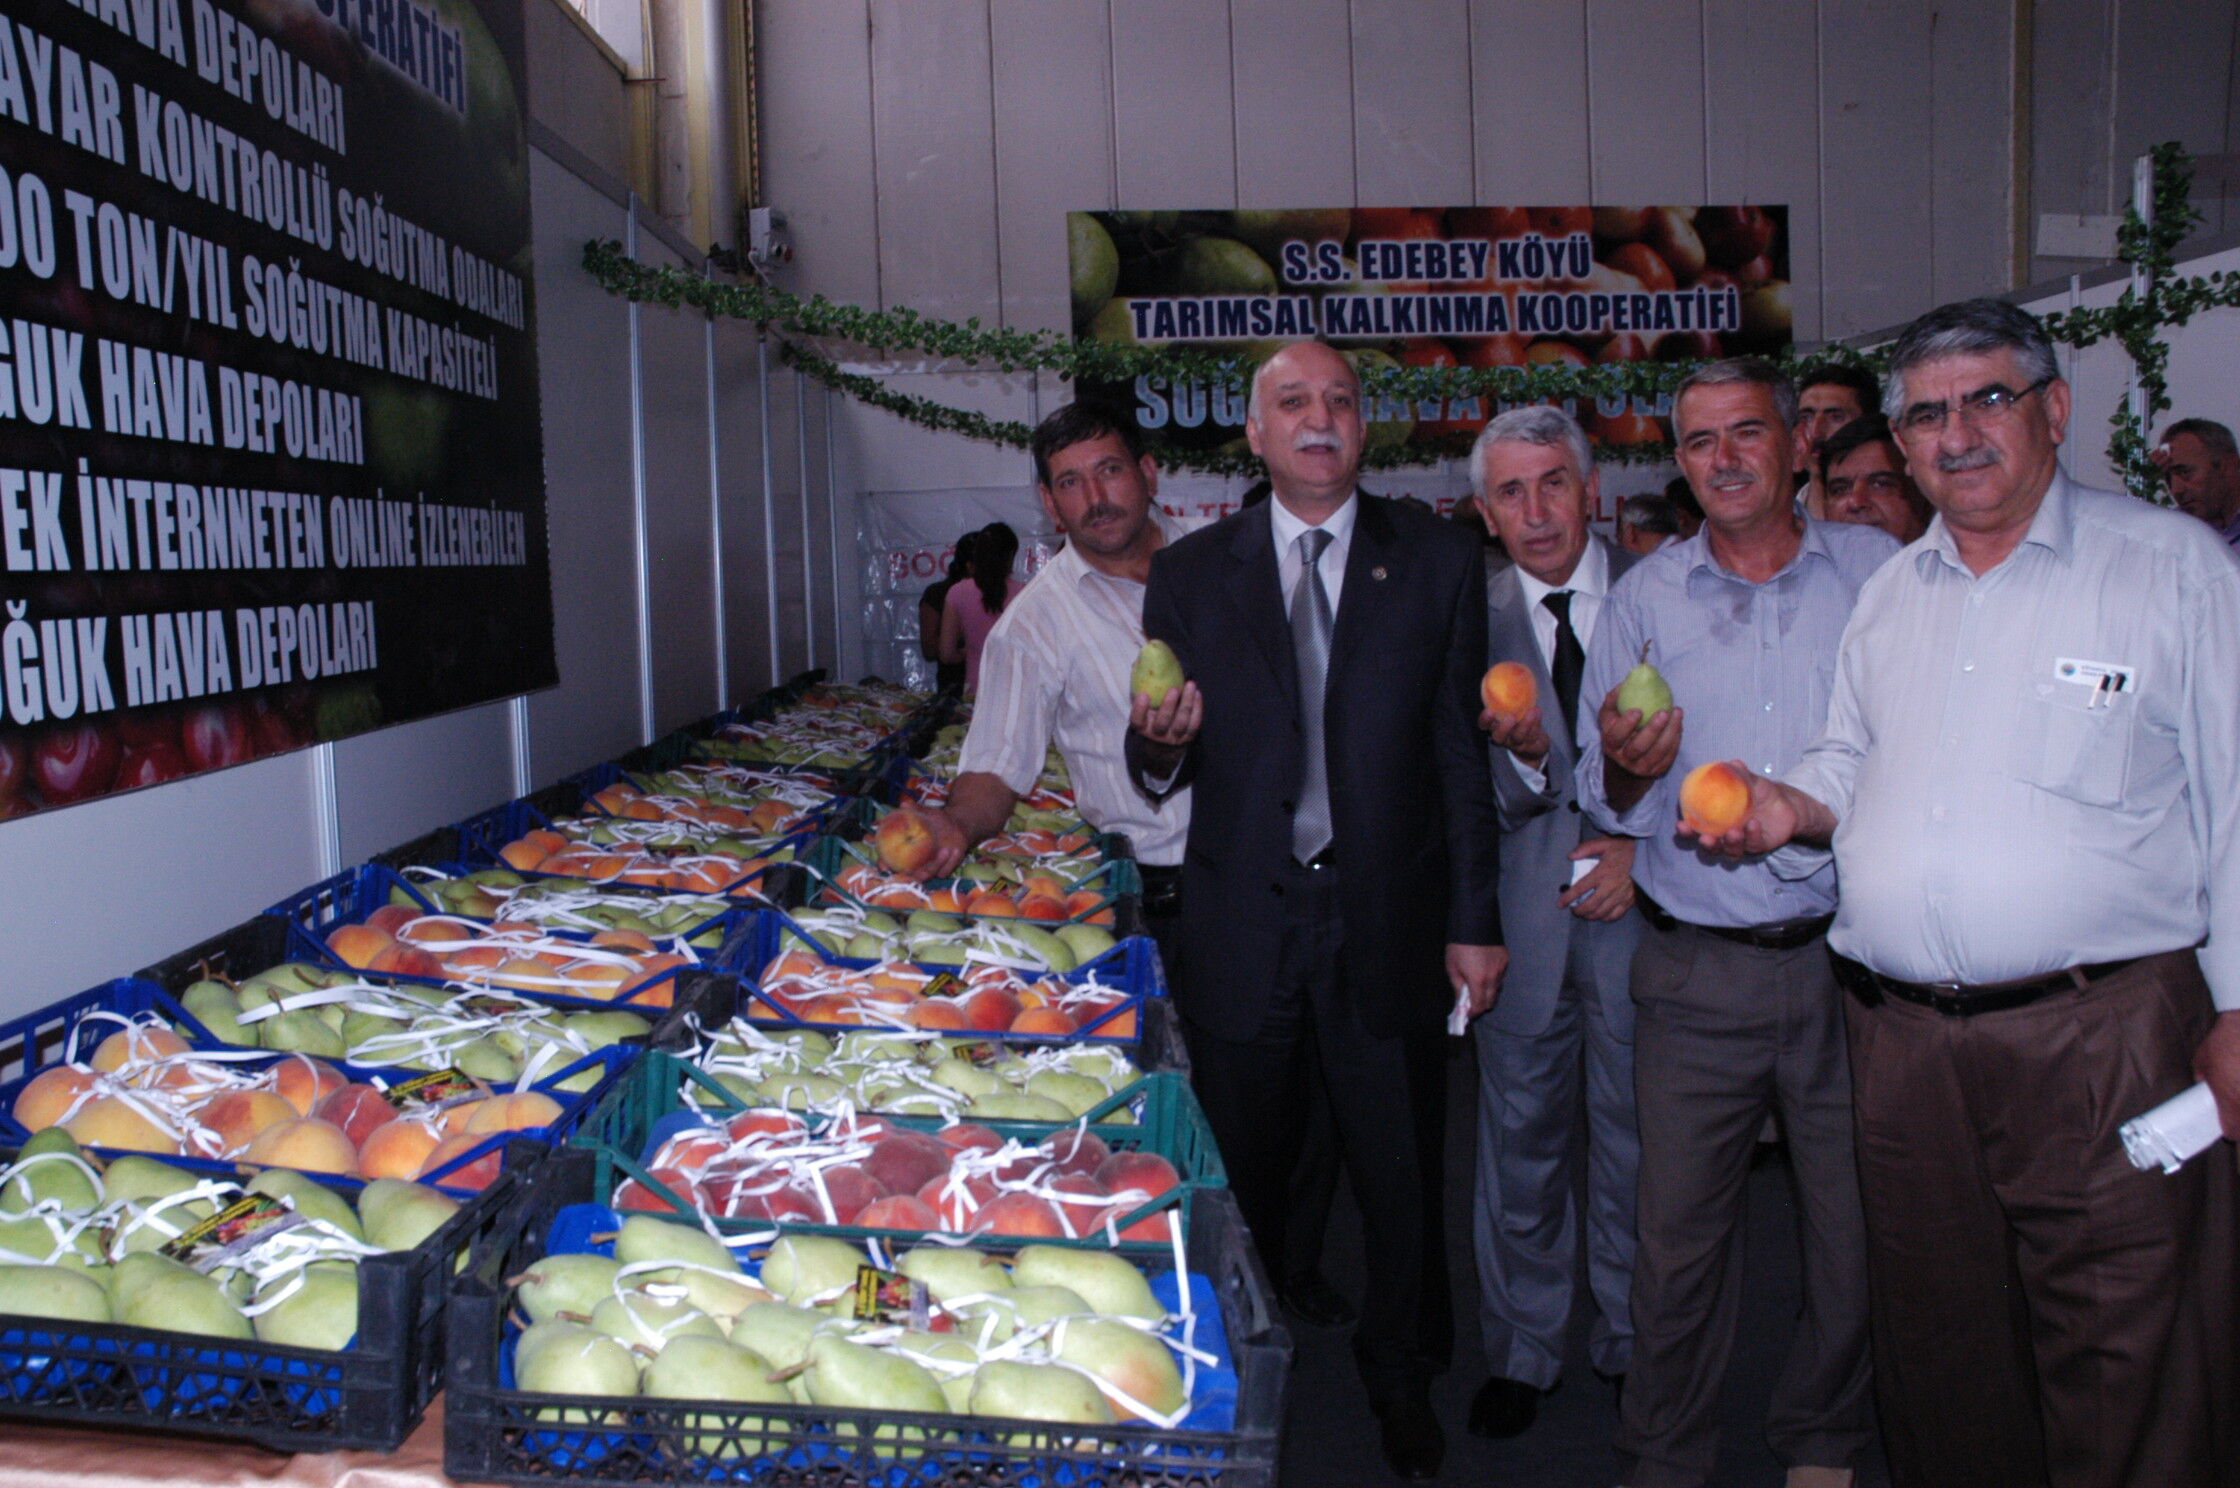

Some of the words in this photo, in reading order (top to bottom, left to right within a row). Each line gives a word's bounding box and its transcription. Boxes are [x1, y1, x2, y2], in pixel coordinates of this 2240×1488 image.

[192, 0, 346, 156] DEPOLARI
[133, 83, 332, 251] KONTROLLÜ
[338, 187, 450, 300] SOĞUTMA
[453, 245, 525, 331] ODALARI
[1285, 243, 1350, 281] S.S.
[1361, 242, 1489, 279] EDEBEY
[1499, 236, 1591, 279] KÖYÜ
[64, 188, 238, 330] TON/YIL
[243, 255, 384, 370] SOĞUTMA
[387, 307, 498, 400] KAPASİTELİ
[1130, 297, 1316, 338] TARIMSAL
[1325, 295, 1508, 334] KALKINMA
[1517, 288, 1737, 331] KOOPERATİFİ
[98, 338, 214, 445] HAVA
[219, 366, 364, 465] DEPOLARI
[77, 457, 325, 571] İNTERNNETEN
[330, 488, 416, 569] ONLİNE
[419, 492, 526, 566] İZLENEBİLEN
[121, 610, 233, 707] HAVA
[236, 601, 377, 689] DEPOLARI
